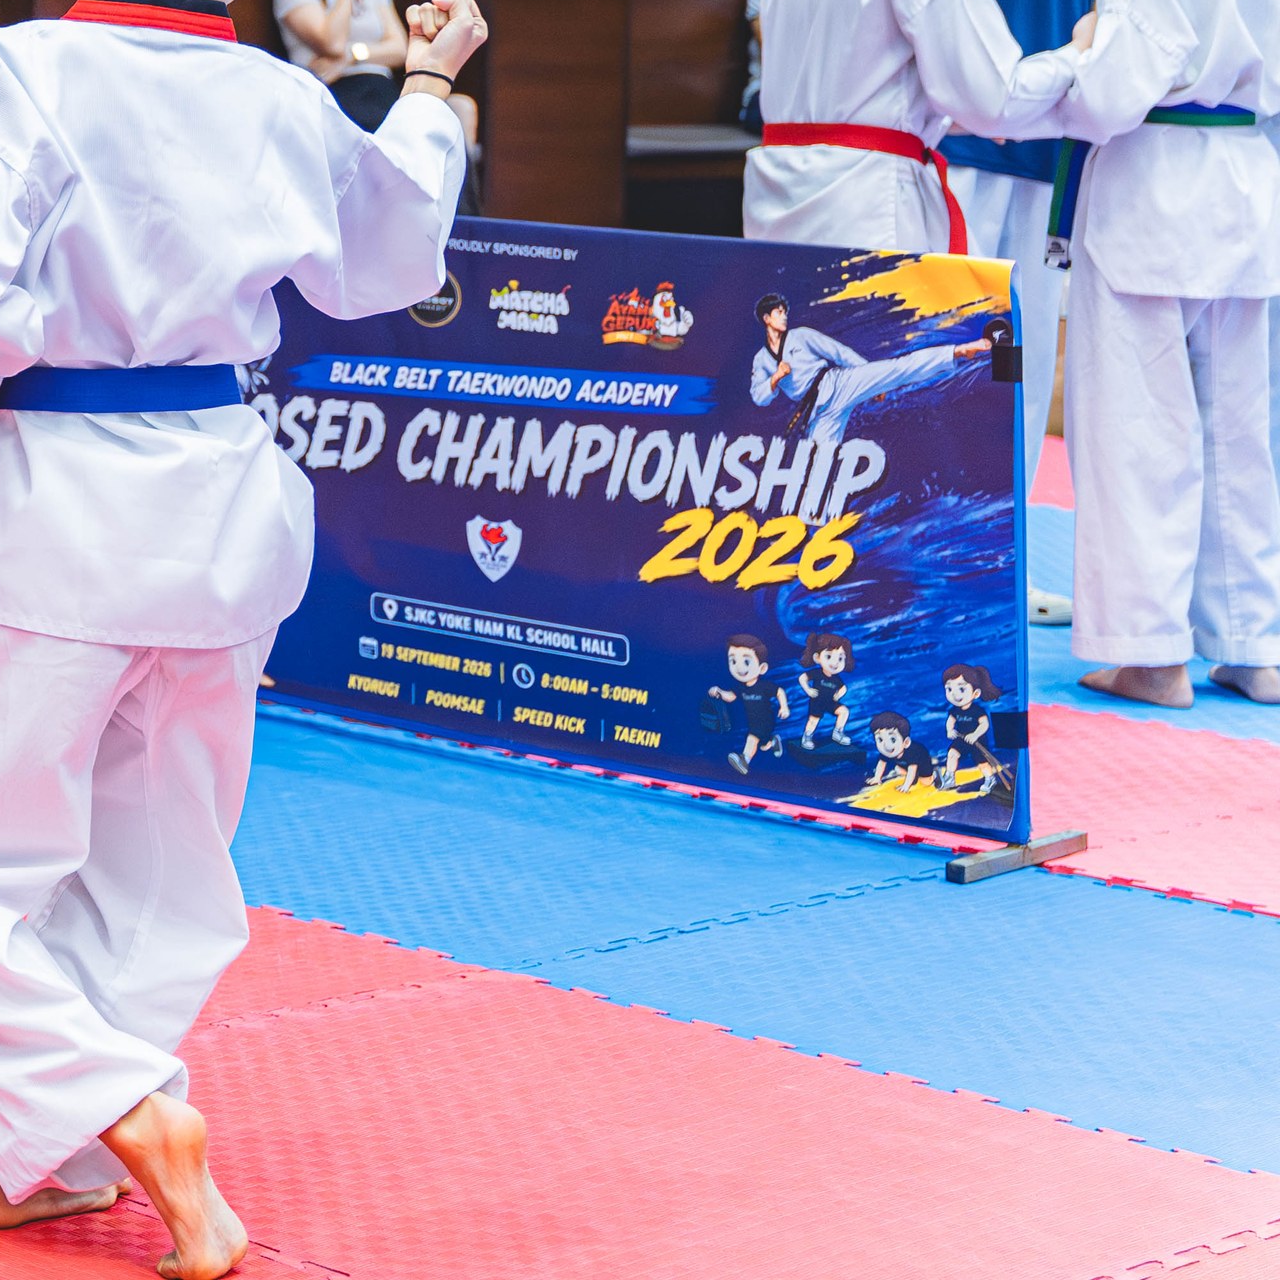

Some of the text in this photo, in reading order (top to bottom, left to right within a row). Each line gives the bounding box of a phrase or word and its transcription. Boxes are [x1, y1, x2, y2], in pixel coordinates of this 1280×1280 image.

[493, 242, 562, 260] SPONSORED
[563, 248, 579, 261] BY
[329, 361, 679, 408] BLACK BELT TAEKWONDO ACADEMY
[249, 392, 887, 523] OSED CHAMPIONSHIP
[638, 506, 863, 591] 2026
[404, 606, 616, 658] SJKC YOKE NAM KL SCHOOL HALL
[381, 643, 493, 678] 19 SEPTEMBER 2026
[347, 674, 400, 699] KYORUGI
[425, 690, 486, 715] POOMSAE
[540, 673, 589, 696] 8:00AM
[601, 684, 648, 706] 5:00PM
[512, 706, 587, 734] SPEED KICK
[613, 725, 662, 748] TAEKIN
